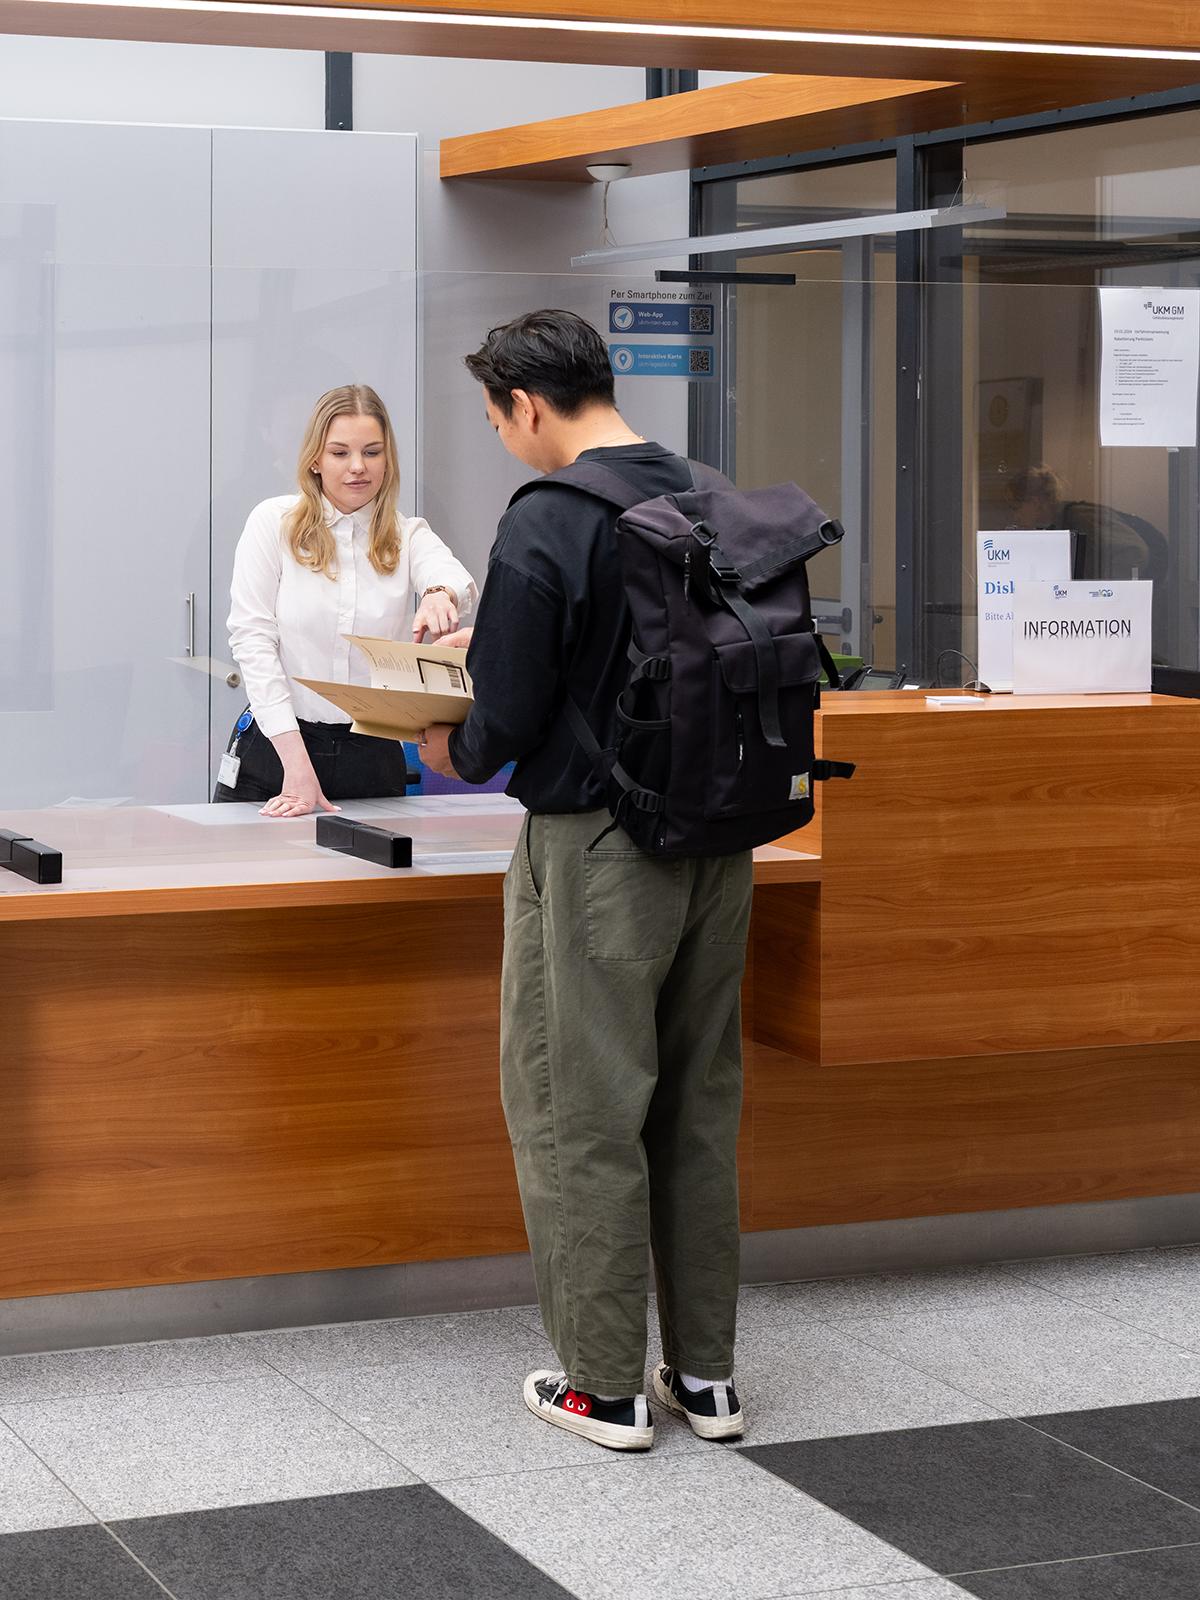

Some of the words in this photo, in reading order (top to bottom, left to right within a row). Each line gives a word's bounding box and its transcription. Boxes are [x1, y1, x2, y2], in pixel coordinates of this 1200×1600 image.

[610, 289, 625, 299] Per
[627, 290, 677, 301] Smartphone
[678, 292, 696, 300] zum
[697, 292, 712, 300] Ziel
[1152, 306, 1171, 315] UKM
[1171, 306, 1185, 315] GM
[987, 549, 1010, 561] UKM
[985, 612, 1004, 621] Bitte
[1024, 619, 1131, 637] INFORMATION
